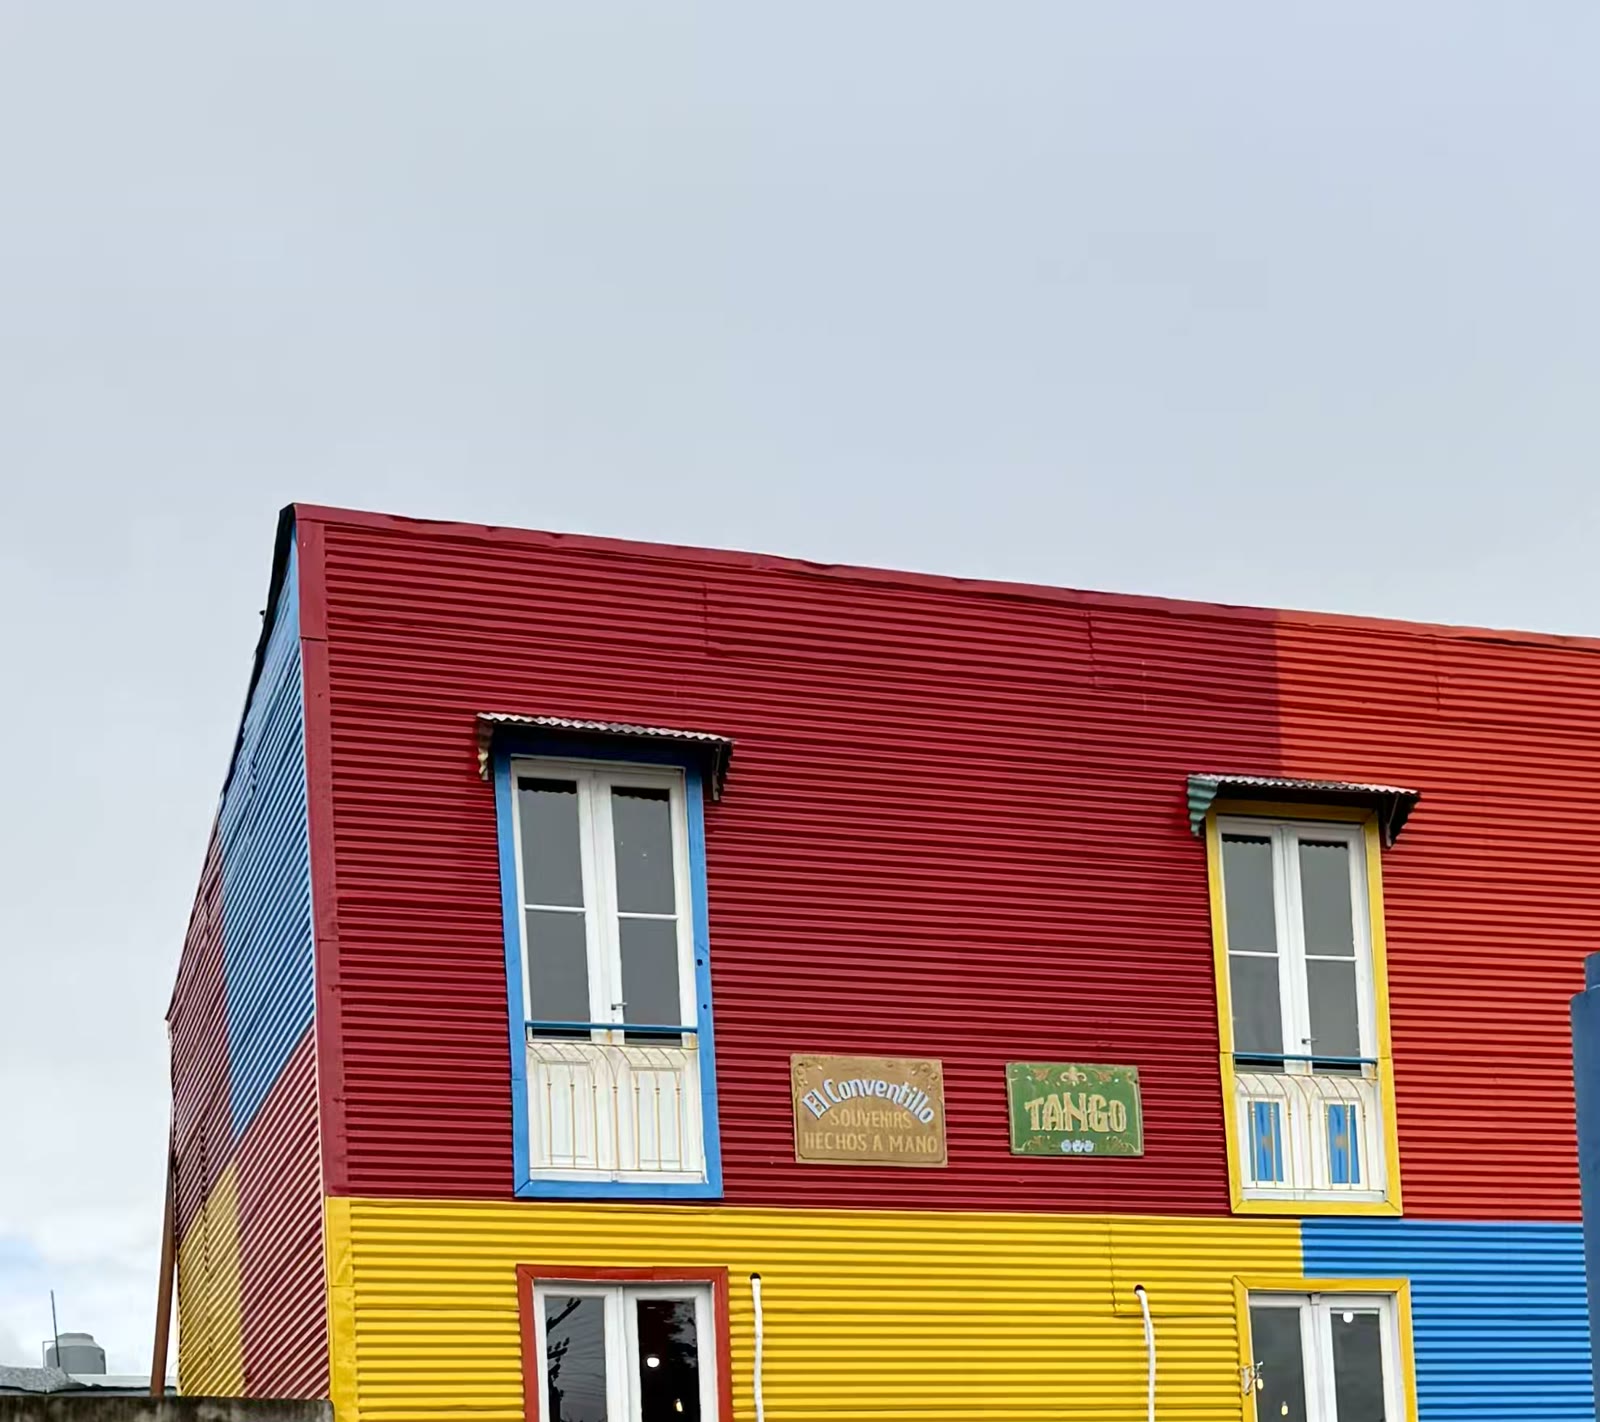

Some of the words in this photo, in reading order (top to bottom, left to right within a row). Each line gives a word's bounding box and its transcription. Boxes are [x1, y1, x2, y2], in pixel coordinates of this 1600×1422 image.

[802, 1088, 832, 1119] El
[823, 1079, 935, 1124] Conventillo
[1024, 1092, 1126, 1132] TANGO
[830, 1108, 913, 1129] SOUVENIRS
[804, 1131, 867, 1150] HECHOS
[873, 1133, 884, 1151] A
[889, 1135, 938, 1153] MANO
